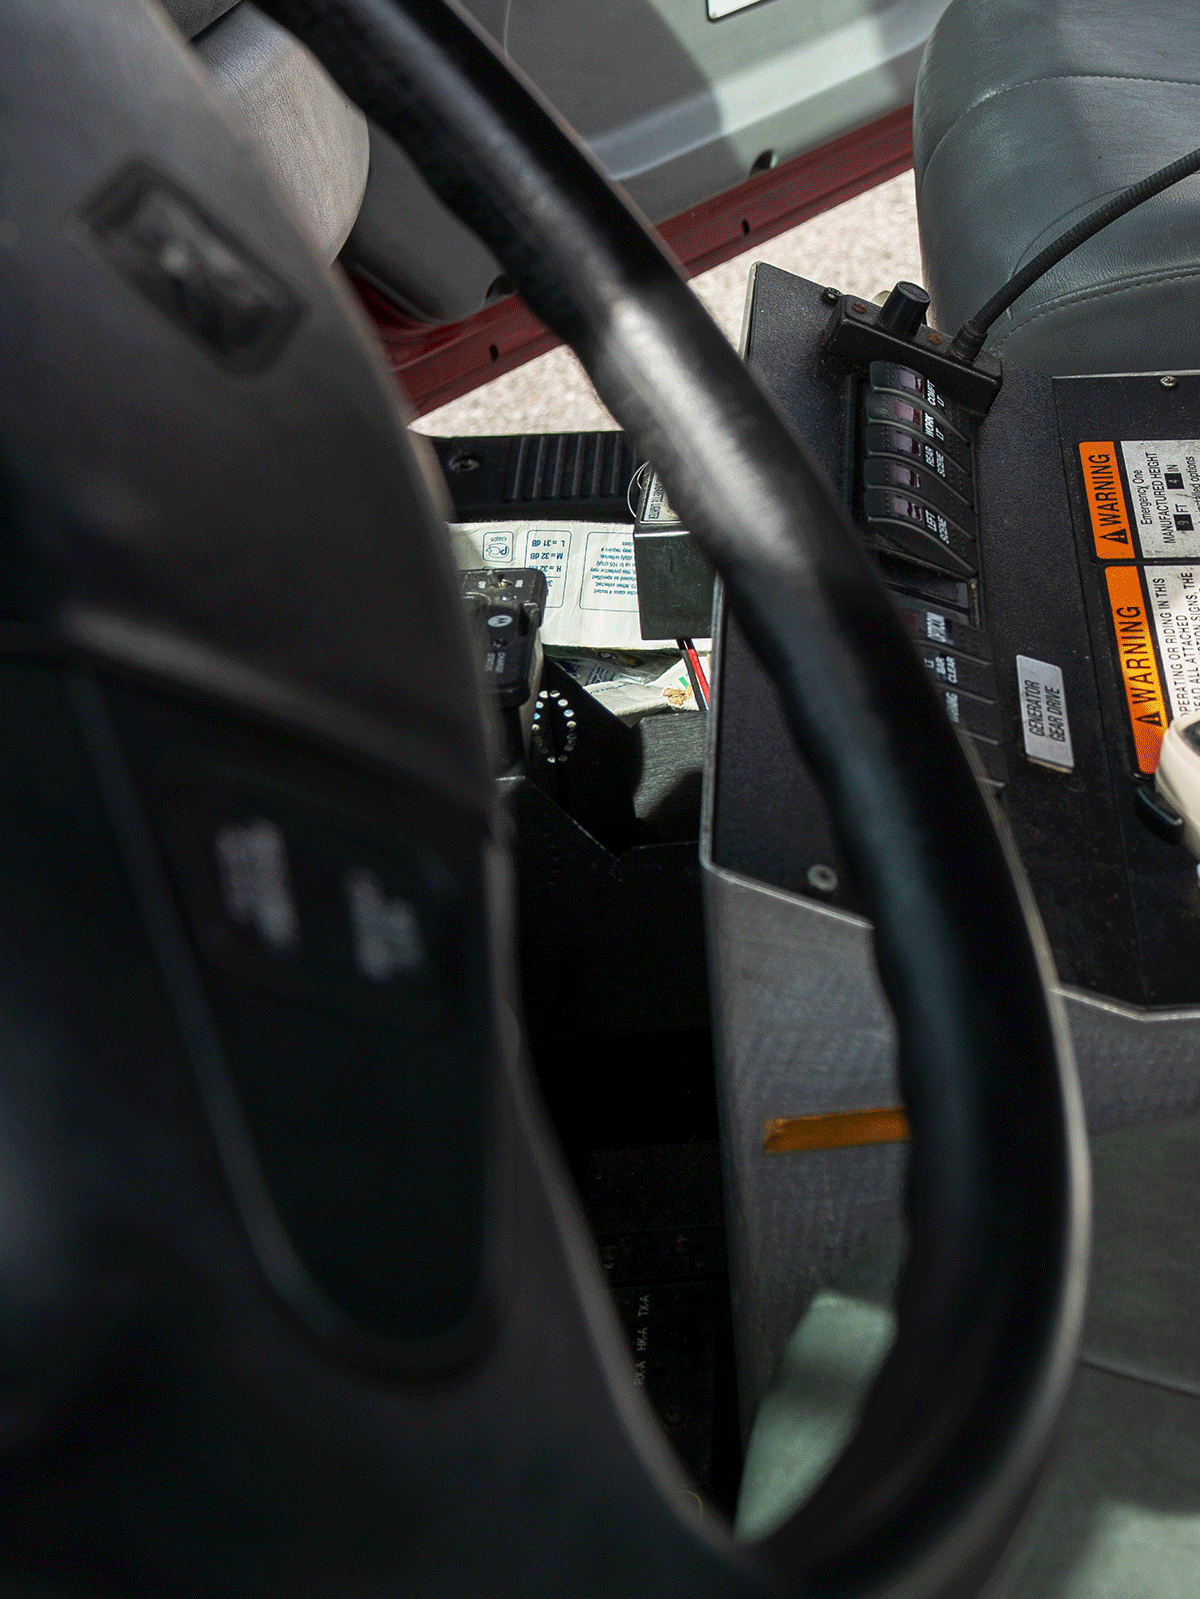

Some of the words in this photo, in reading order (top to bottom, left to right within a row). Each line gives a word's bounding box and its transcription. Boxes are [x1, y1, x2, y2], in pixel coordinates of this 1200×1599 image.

[937, 395, 945, 407] LT
[925, 412, 934, 438] WORK
[936, 428, 944, 441] LT
[925, 446, 935, 467] REAR
[936, 451, 946, 477] SCENE
[1146, 452, 1163, 478] HEIGHT
[1186, 456, 1200, 482] options
[1089, 454, 1121, 526] WARNING
[1132, 470, 1144, 484] One
[1138, 485, 1152, 524] Emergency
[1152, 481, 1175, 543] MANUFACTURED
[1175, 504, 1188, 512] FT
[925, 509, 937, 532] LEFT
[937, 515, 950, 544] SCENE
[541, 552, 550, 560] 32
[1153, 578, 1168, 597] THIS
[1181, 572, 1195, 589] THE
[1158, 601, 1170, 609] IN
[1160, 612, 1178, 643] RIDING
[1176, 615, 1197, 663] ATTACHED
[1116, 607, 1157, 704] WARNING
[1167, 648, 1181, 660] OR
[1024, 680, 1045, 736] GENERATOR
[1045, 685, 1062, 716] DRIVE
[1048, 715, 1065, 742] GEAR
